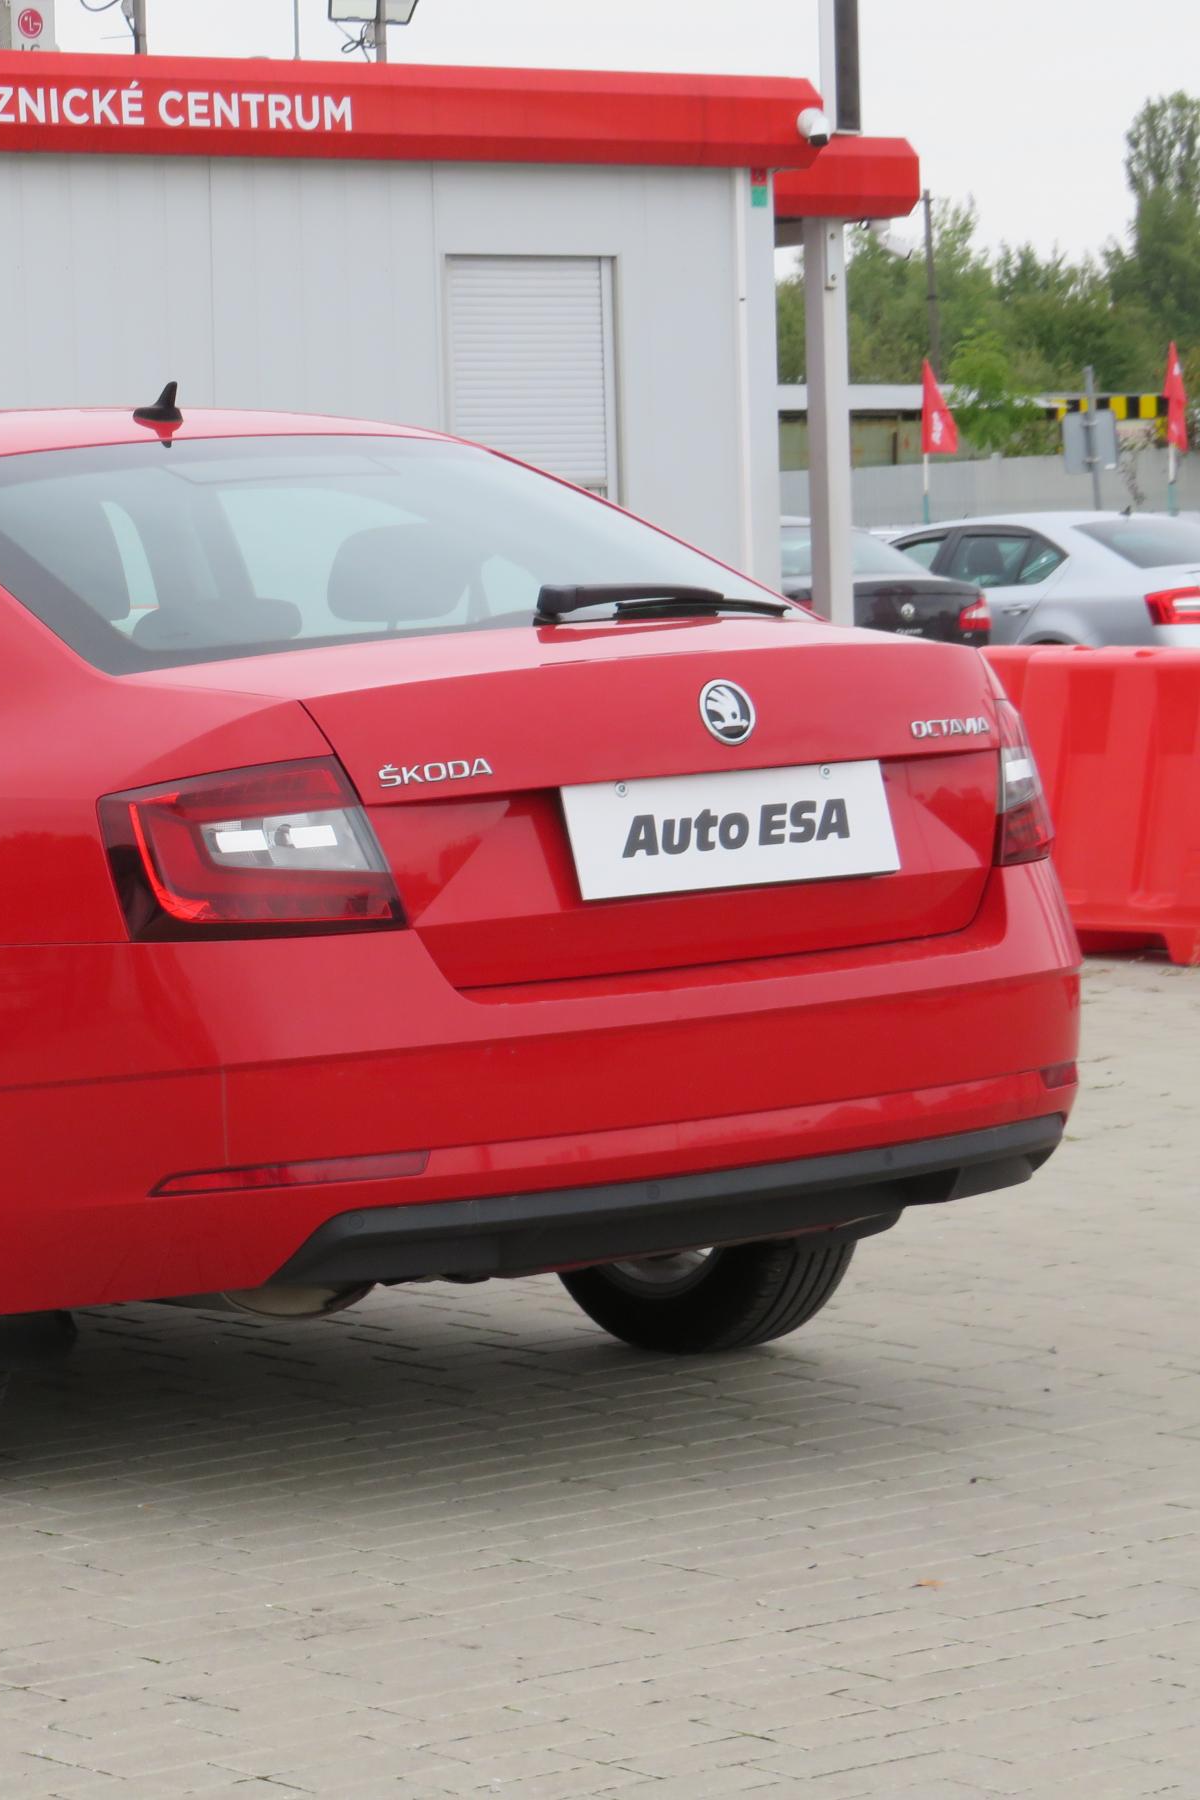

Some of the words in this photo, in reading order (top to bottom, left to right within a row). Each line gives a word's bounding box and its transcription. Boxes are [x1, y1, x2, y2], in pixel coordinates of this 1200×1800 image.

[158, 90, 353, 132] CENTRUM
[911, 716, 990, 739] OCTAVIA
[378, 758, 493, 788] ŠKODA
[622, 808, 750, 858] Auto
[758, 798, 850, 846] ESA
